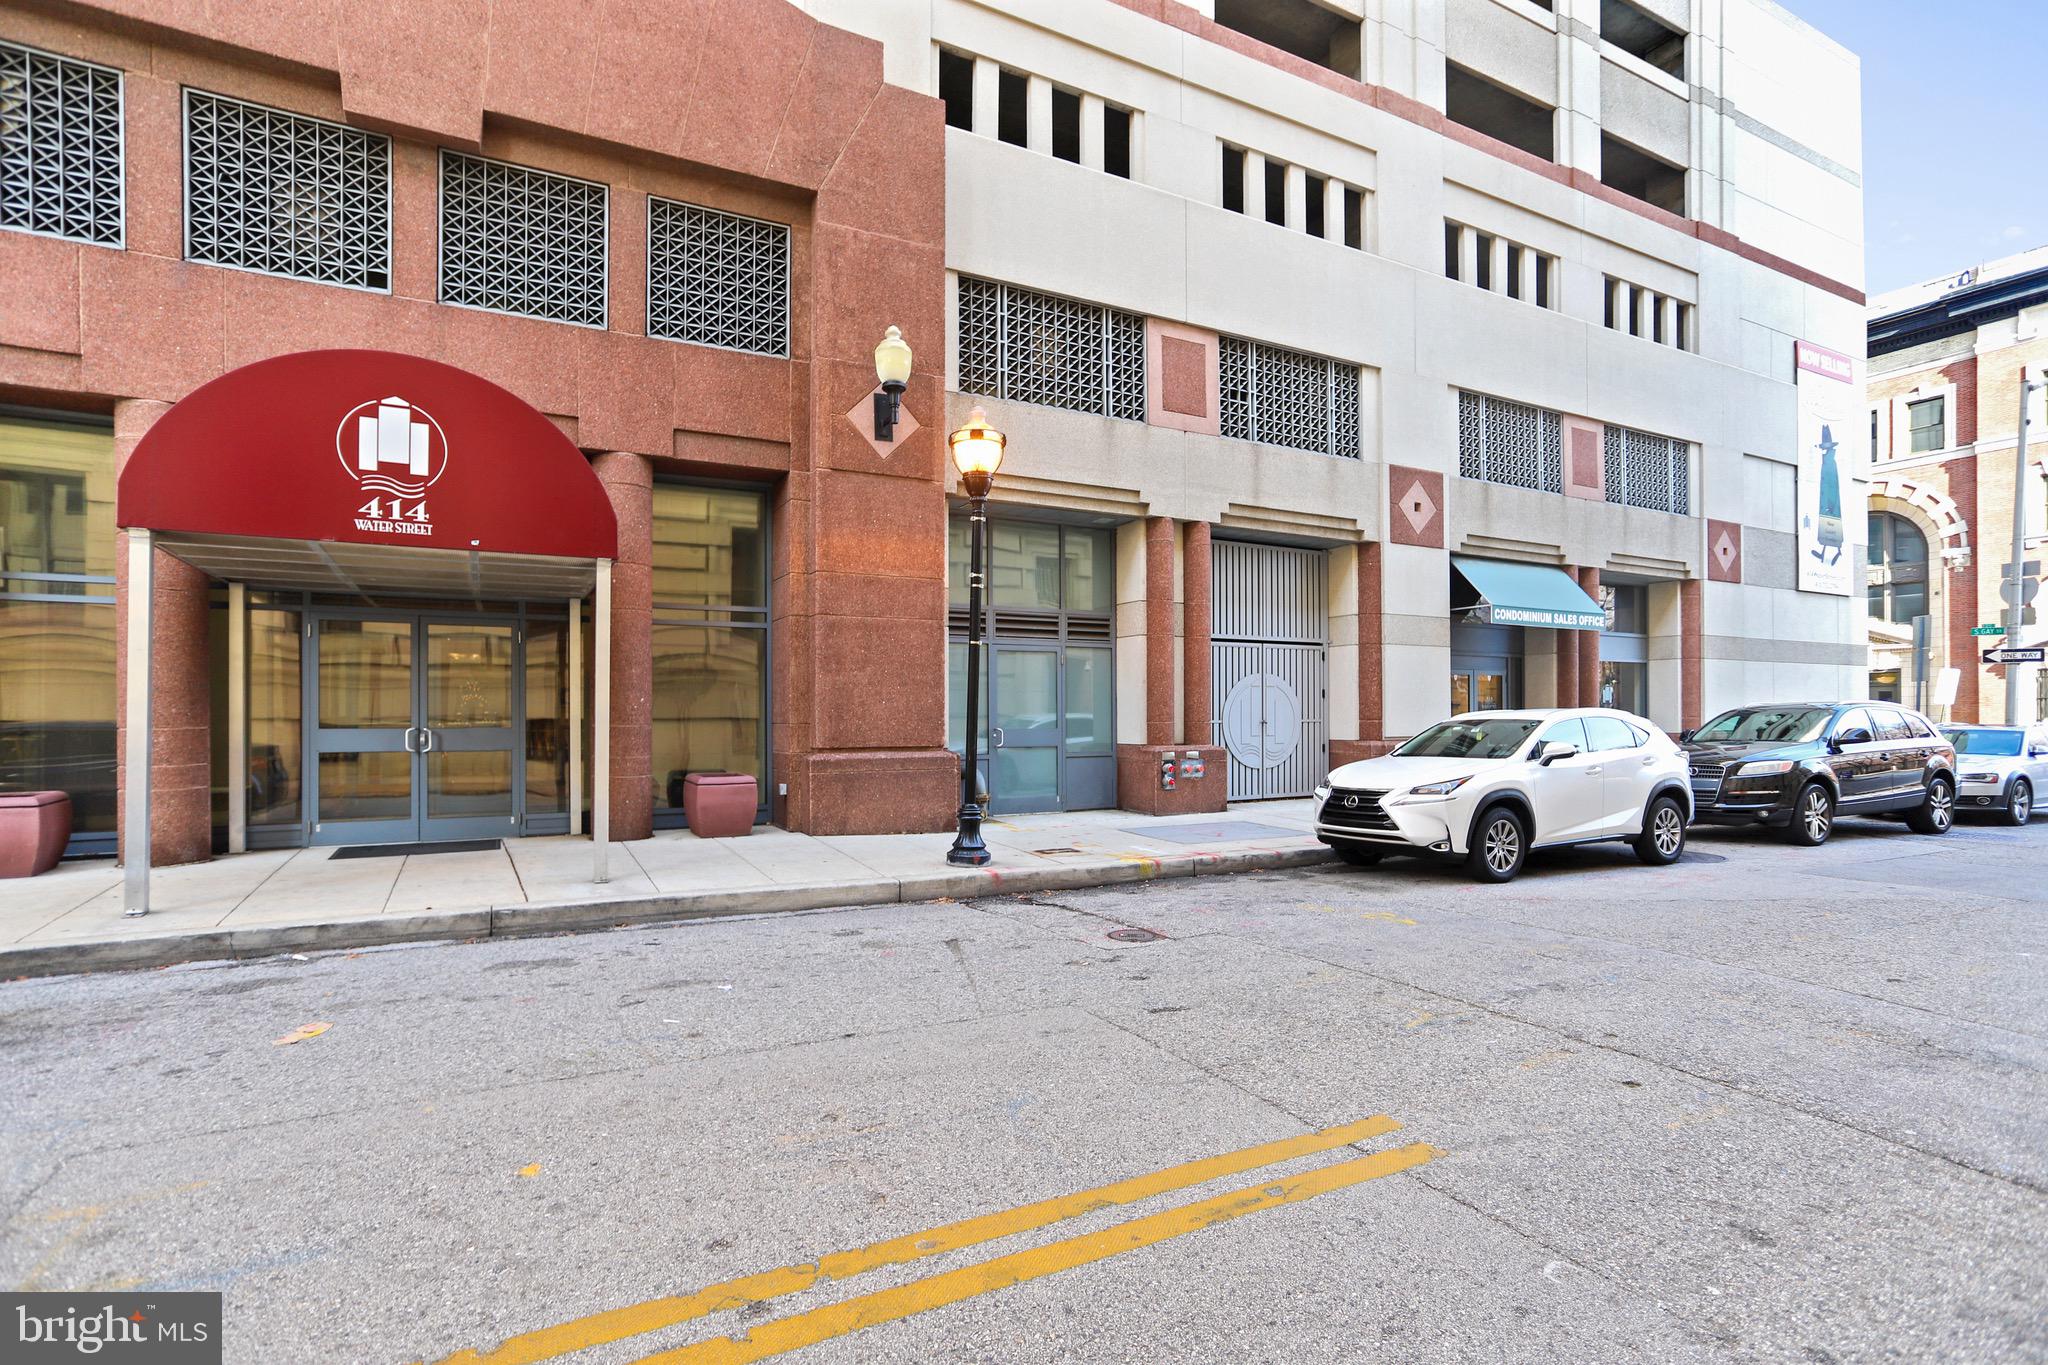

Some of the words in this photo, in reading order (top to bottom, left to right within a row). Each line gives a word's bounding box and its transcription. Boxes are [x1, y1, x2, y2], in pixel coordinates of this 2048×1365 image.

[357, 496, 430, 523] 414
[354, 519, 394, 533] WATER
[395, 522, 433, 536] STREET
[1494, 608, 1552, 624] CONDOMINIUM
[1553, 613, 1577, 625] SALES
[1578, 614, 1605, 627] OFFICE
[2021, 651, 2039, 659] WAY
